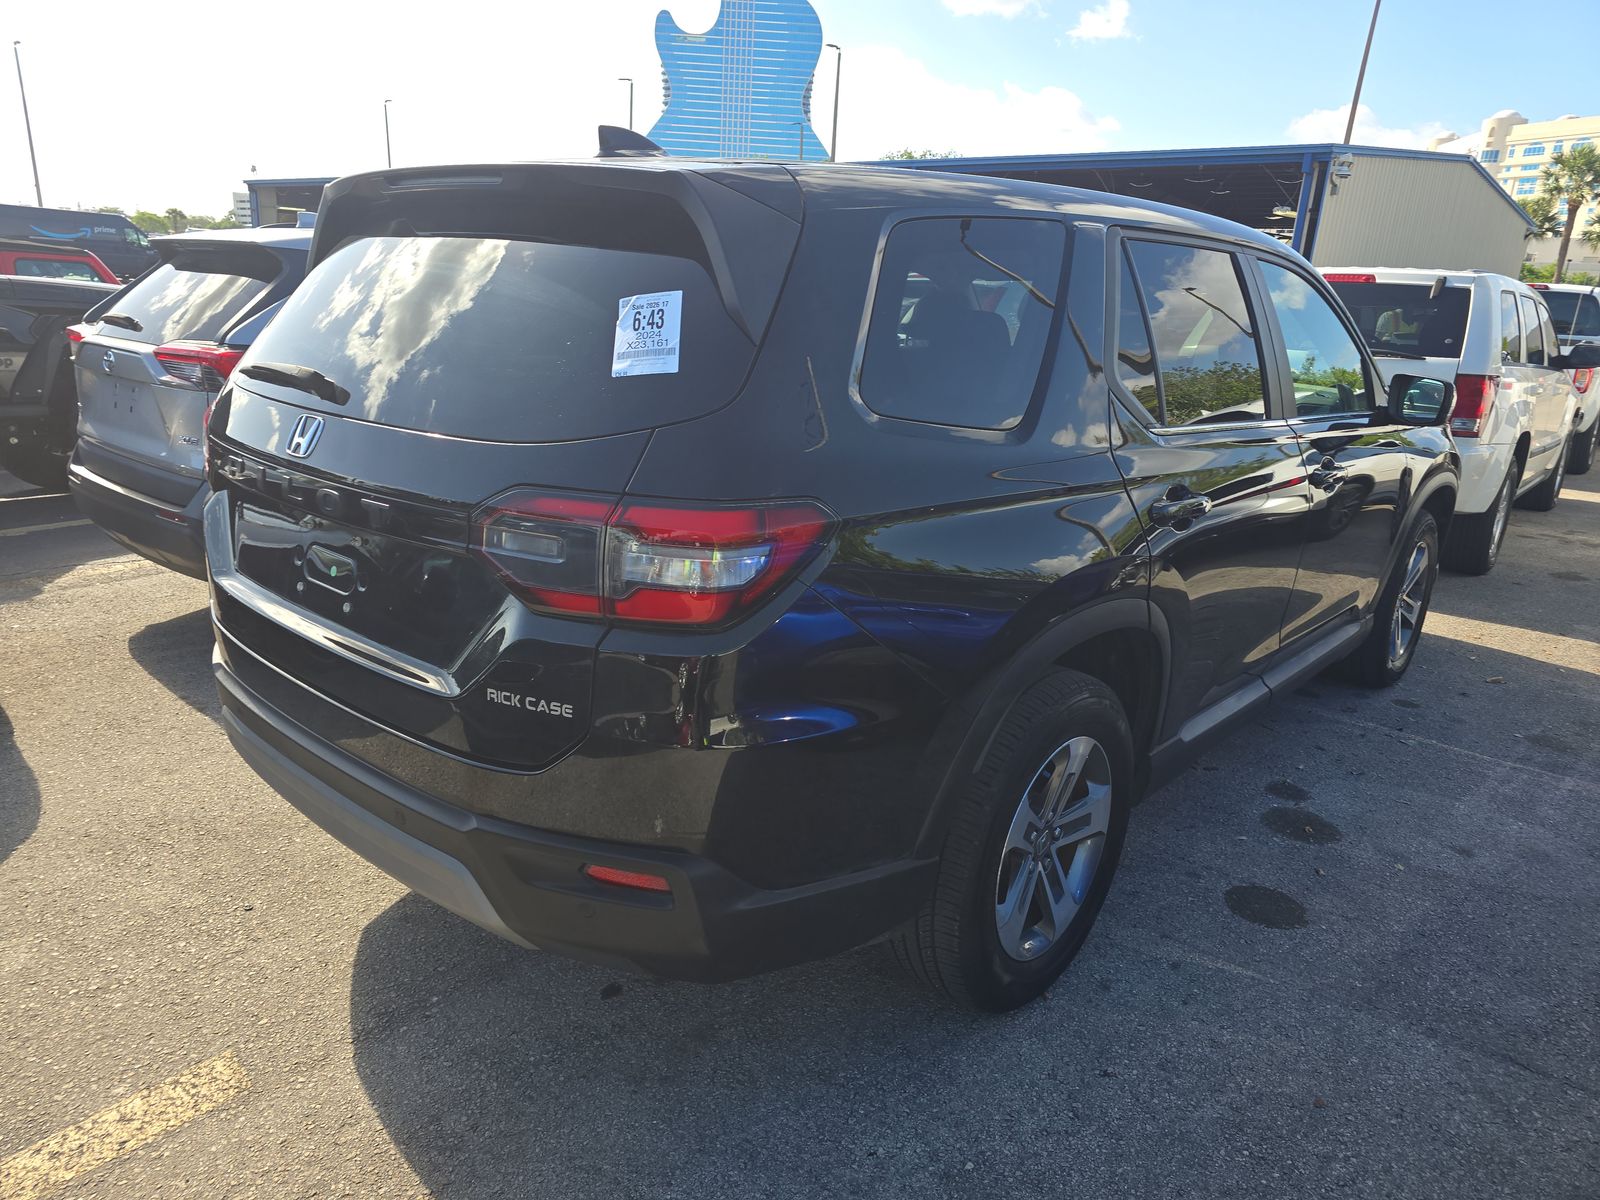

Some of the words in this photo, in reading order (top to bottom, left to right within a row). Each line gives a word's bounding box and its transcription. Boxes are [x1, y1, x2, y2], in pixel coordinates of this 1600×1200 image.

[94, 226, 117, 234] prime
[633, 308, 665, 331] 6:43
[635, 330, 662, 340] 2024
[487, 688, 521, 707] RICK
[525, 696, 573, 718] CASE
